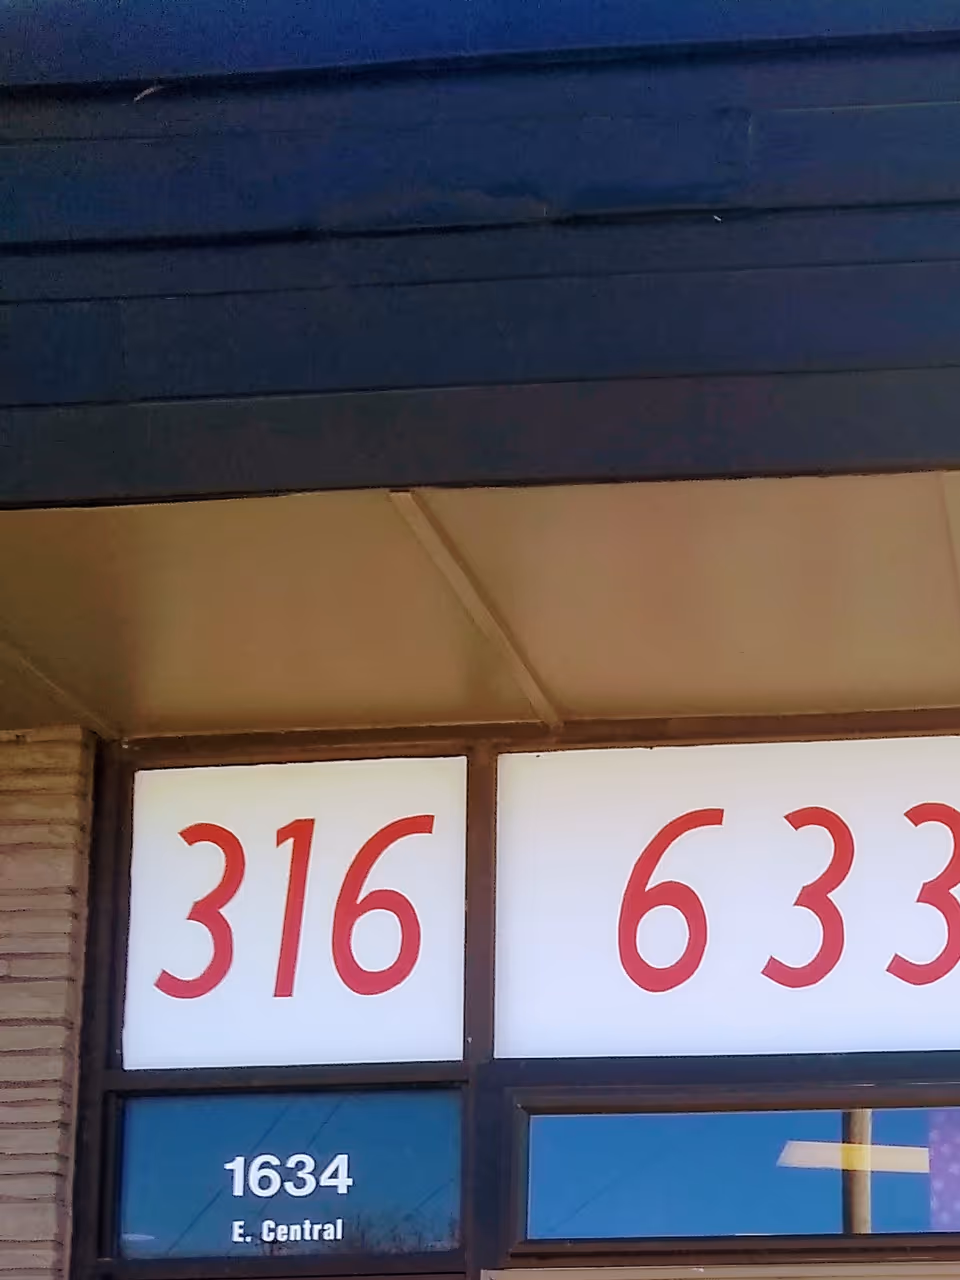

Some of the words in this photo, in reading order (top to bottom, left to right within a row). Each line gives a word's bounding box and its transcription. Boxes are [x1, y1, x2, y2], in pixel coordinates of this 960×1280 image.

[155, 814, 435, 999] 316
[224, 1154, 353, 1197] 1634
[233, 1220, 252, 1242] E.
[261, 1219, 343, 1242] Central
